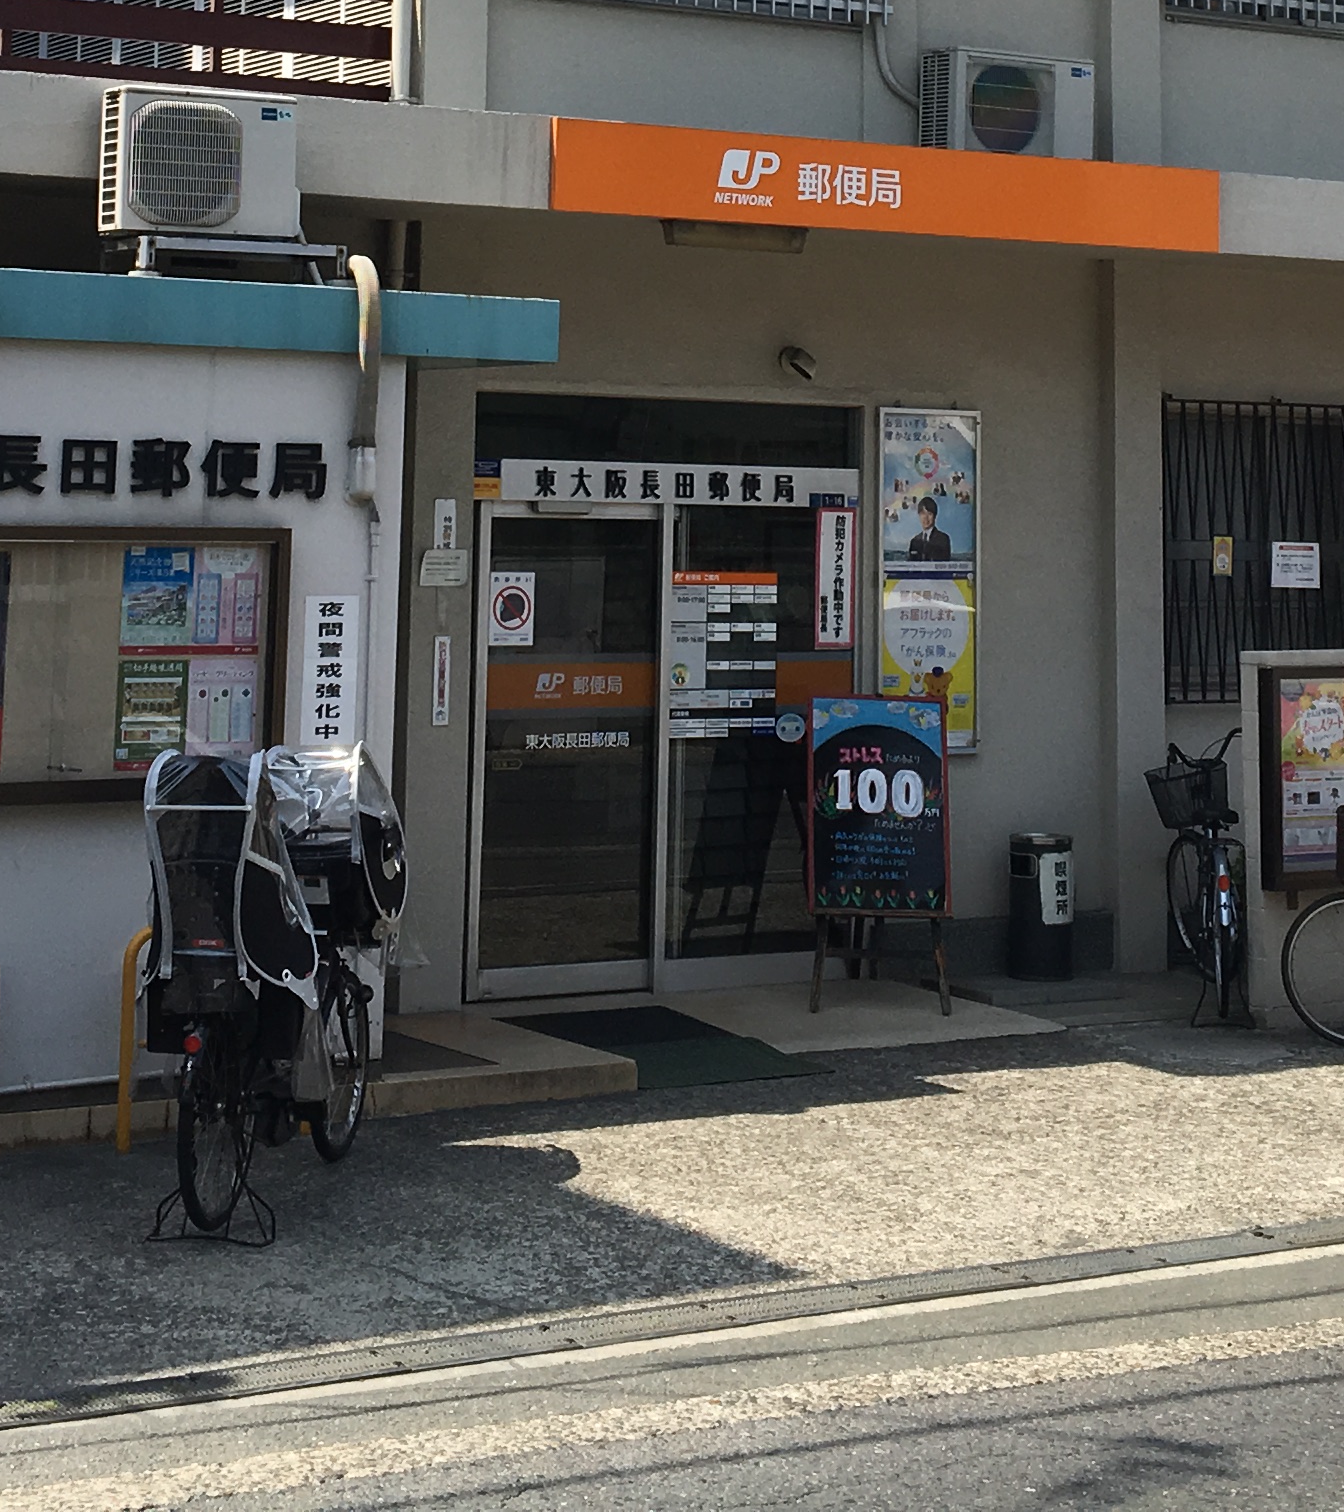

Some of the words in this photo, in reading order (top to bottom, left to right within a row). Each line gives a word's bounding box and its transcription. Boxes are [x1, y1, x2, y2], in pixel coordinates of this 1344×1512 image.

[798, 163, 902, 209] 郵便局
[714, 192, 774, 207] NETWORK
[535, 466, 795, 503] 東大阪長田郵便局
[825, 496, 843, 506] 1-16
[833, 515, 846, 638] 防犯カメラ作動中です
[900, 627, 952, 639] アフラックの
[314, 601, 345, 740] 夜間警戒強化中
[573, 676, 623, 695] 郵便局
[525, 732, 630, 750] 東大阪長田郵便局
[839, 746, 884, 764] ストレス
[833, 768, 925, 818] 100
